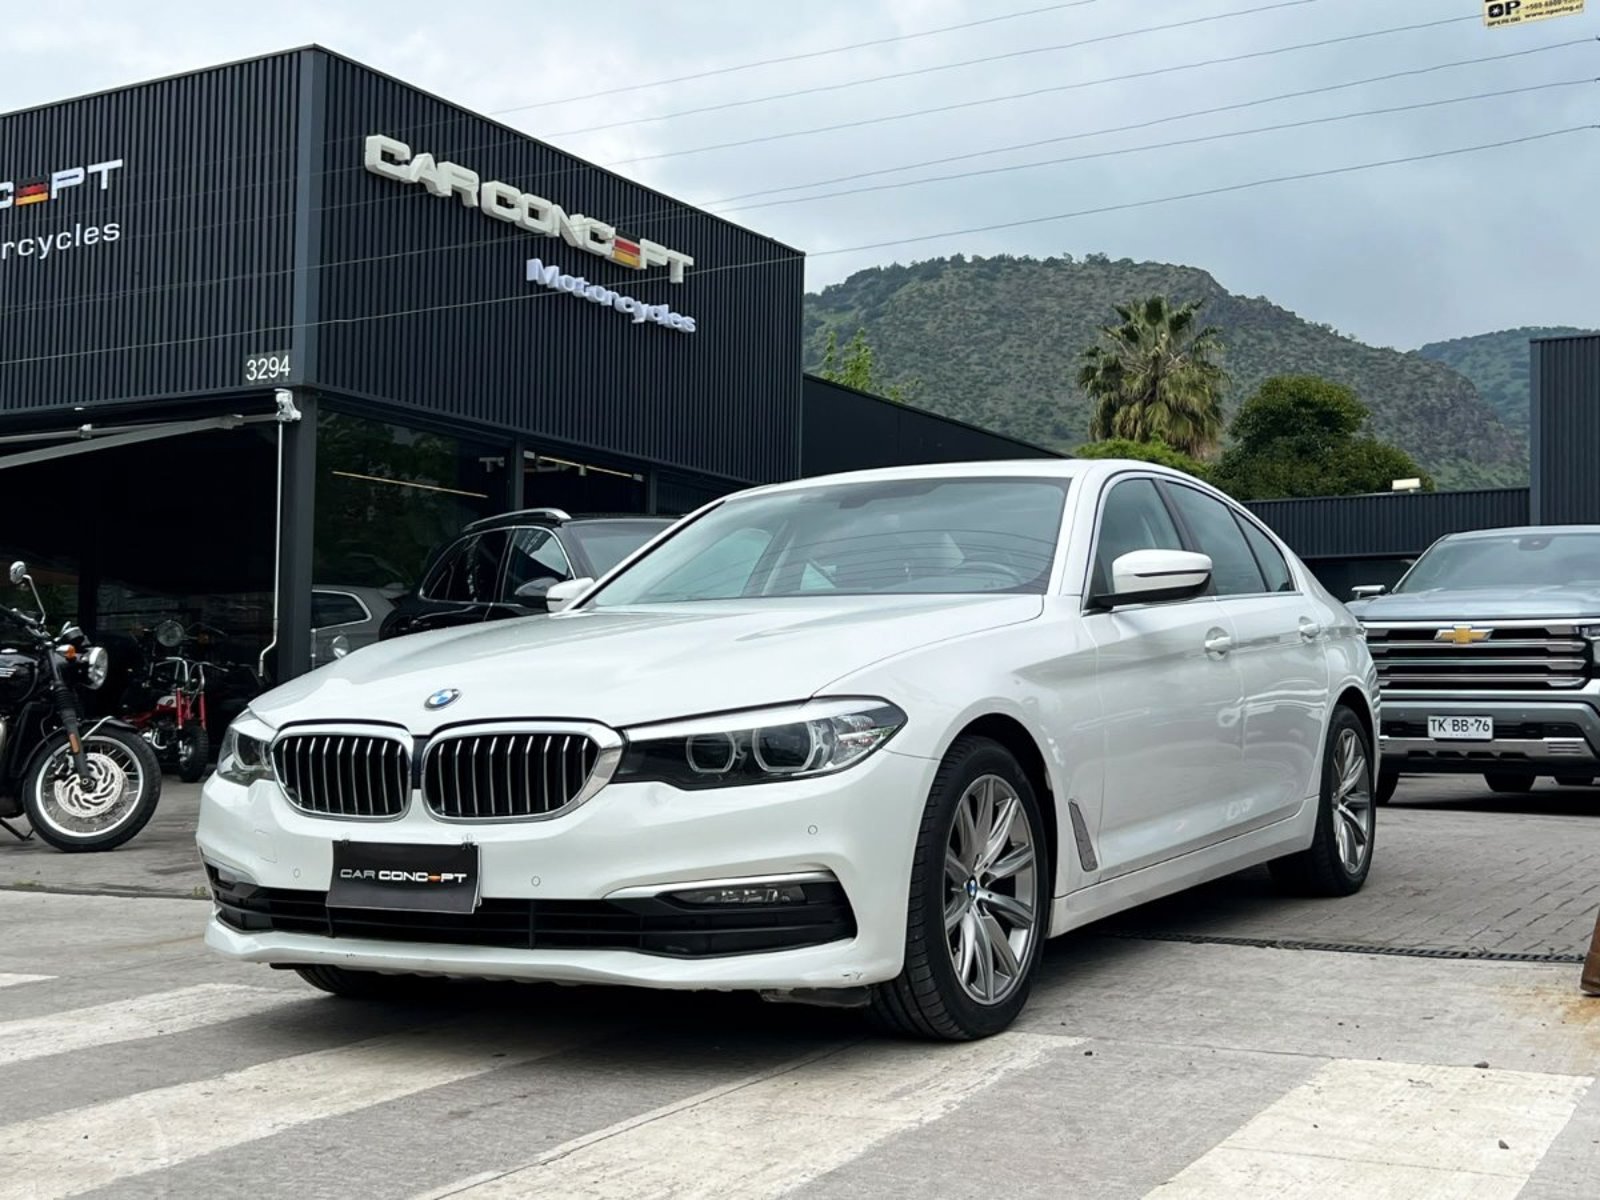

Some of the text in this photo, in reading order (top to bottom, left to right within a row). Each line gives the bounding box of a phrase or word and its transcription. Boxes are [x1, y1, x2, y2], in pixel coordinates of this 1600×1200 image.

[1488, 1, 1520, 18] OP
[365, 134, 480, 207] CAR
[2, 222, 120, 260] rcycles
[526, 258, 696, 333] Motorcycles
[246, 355, 291, 380] 3294
[1430, 718, 1446, 732] TK
[340, 869, 376, 880] CAR
